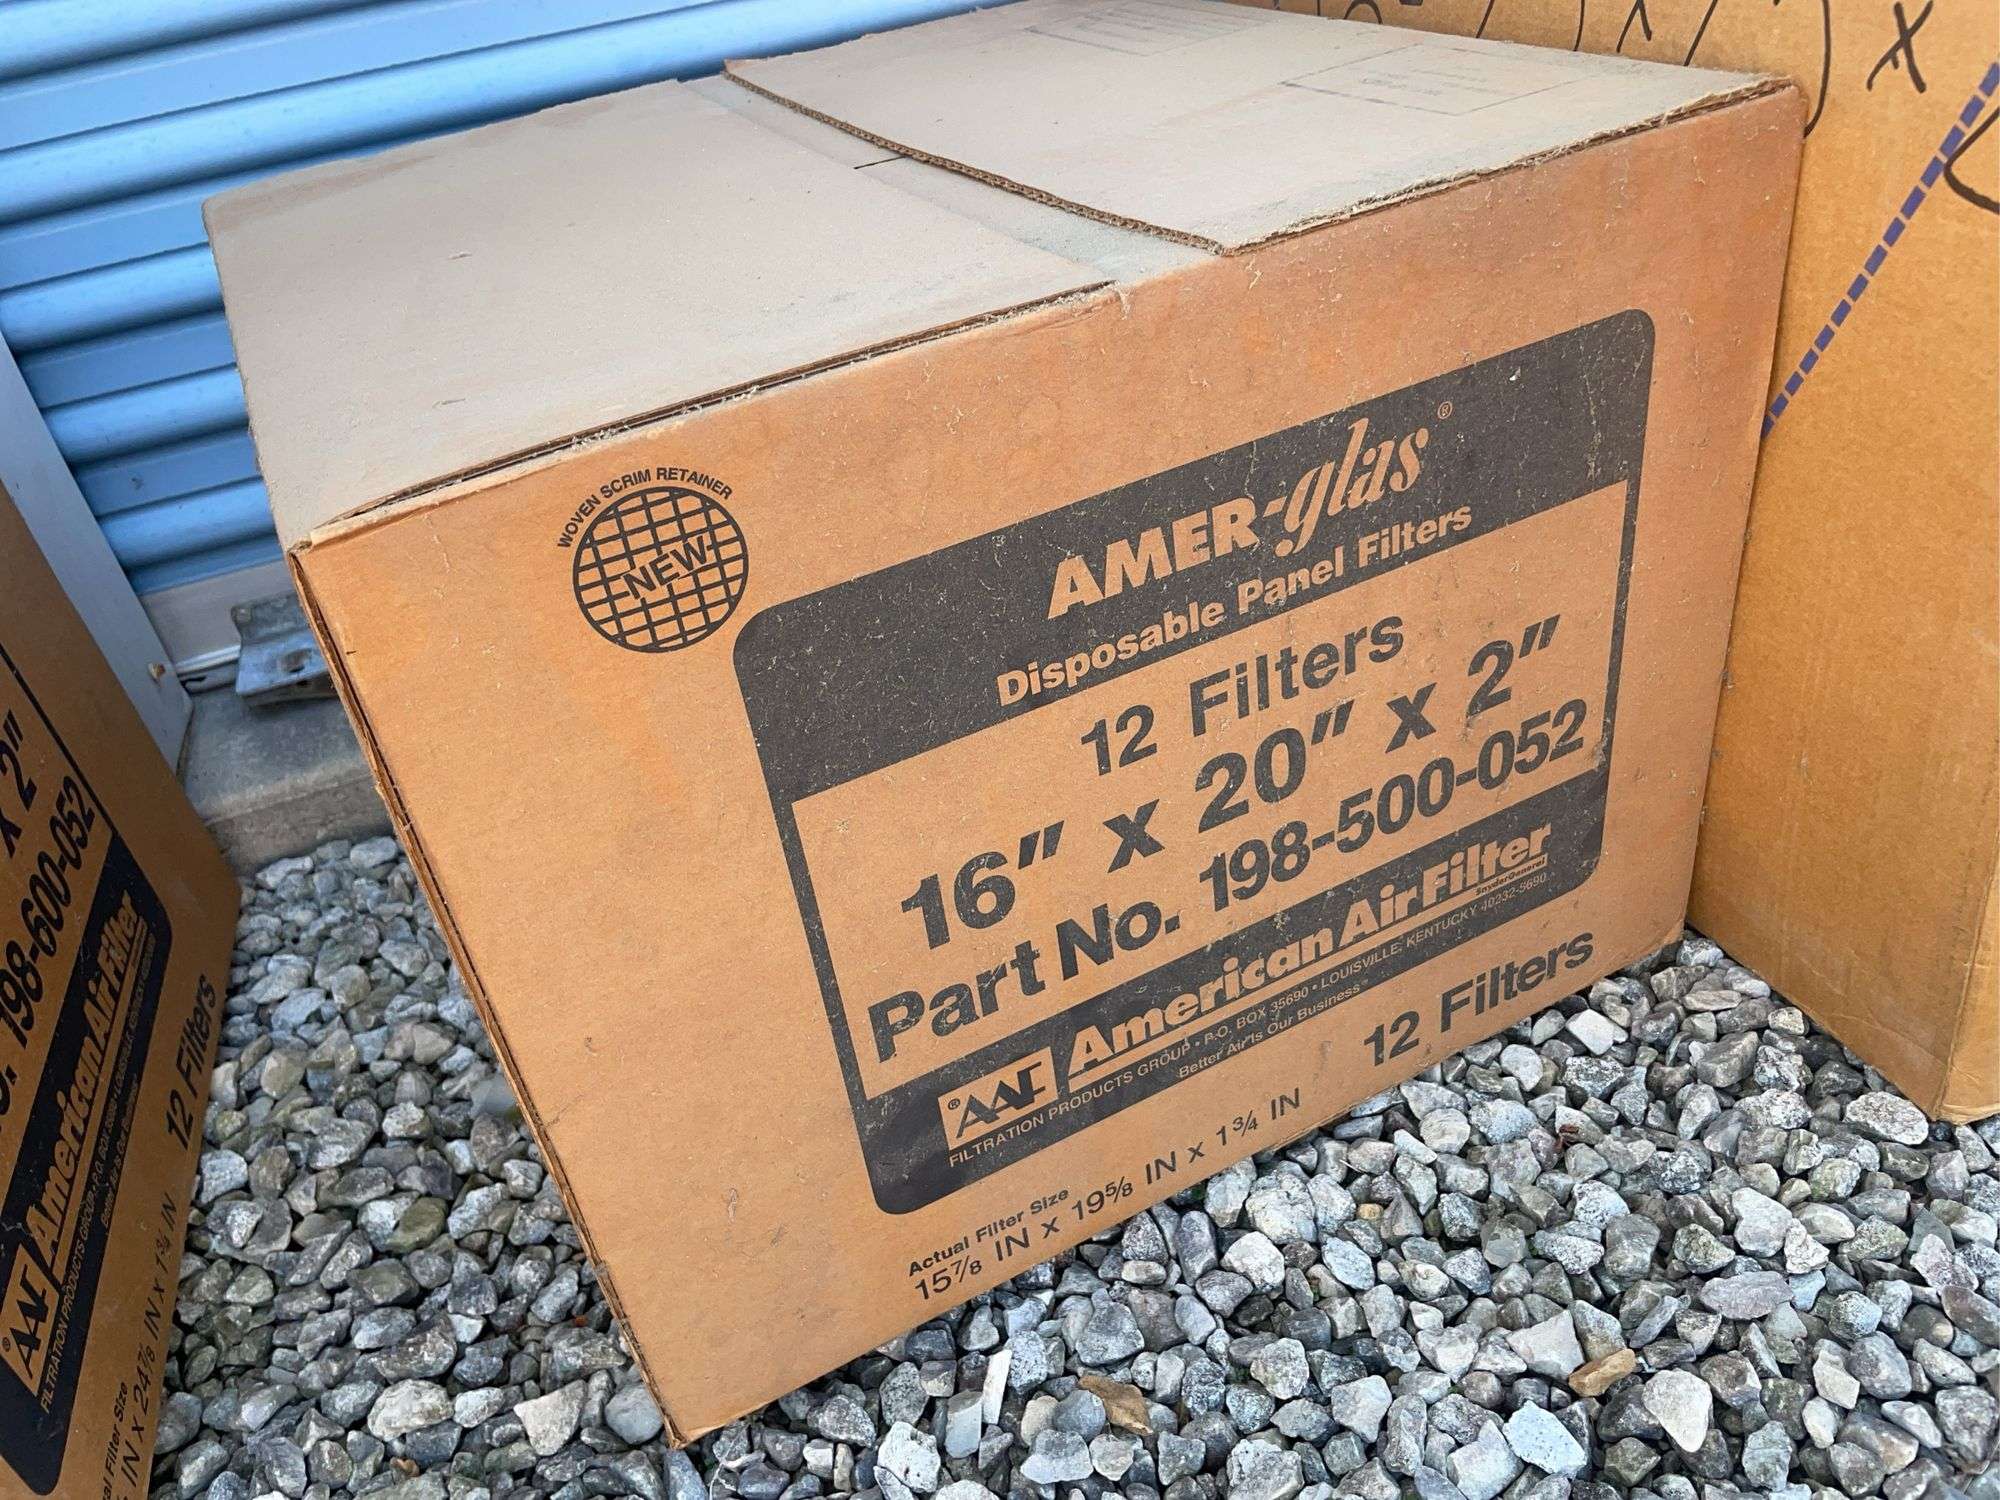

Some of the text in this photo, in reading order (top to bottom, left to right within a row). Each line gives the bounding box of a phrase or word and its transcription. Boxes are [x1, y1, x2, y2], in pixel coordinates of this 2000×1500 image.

[557, 467, 732, 548] WOVEN SCRIM RETAINER
[623, 536, 708, 600] NEW
[996, 503, 1472, 706] Disposable Panel Filters
[1081, 615, 1404, 776] 12 Filters
[1103, 799, 1164, 872] x
[1386, 683, 1436, 753] x
[869, 699, 1584, 1062] Part No. 198-500-052
[167, 973, 216, 1151] 12 Filters
[950, 1114, 1044, 1168] FILTRATION
[1049, 1071, 1134, 1121] PRODUCTS
[1138, 1041, 1191, 1076] GROUP
[1236, 1007, 1267, 1029] BOX
[1270, 987, 1309, 1014] 35690
[1407, 904, 1477, 948] KENTUCKY
[1068, 928, 1333, 1075] American
[1179, 1050, 1222, 1078] Better
[1267, 1015, 1293, 1035] Our
[1297, 983, 1360, 1020] Business
[1364, 932, 1593, 1067] 12 Filters
[909, 1188, 1069, 1277] Actual Filter Size
[994, 1226, 1029, 1262] IN
[1041, 1217, 1061, 1239] x
[1145, 1150, 1178, 1185] IN
[1187, 1140, 1206, 1164] x
[1270, 1087, 1301, 1120] IN
[40, 1320, 69, 1414] FILTRATION
[62, 1242, 86, 1320] PRODUCTS
[121, 1439, 141, 1488] IN
[131, 1414, 145, 1444] x
[144, 1296, 162, 1341] IN
[153, 1278, 165, 1304] x
[161, 1192, 177, 1232] IN
[105, 1424, 121, 1477] Filter
[114, 1382, 128, 1422] Size
